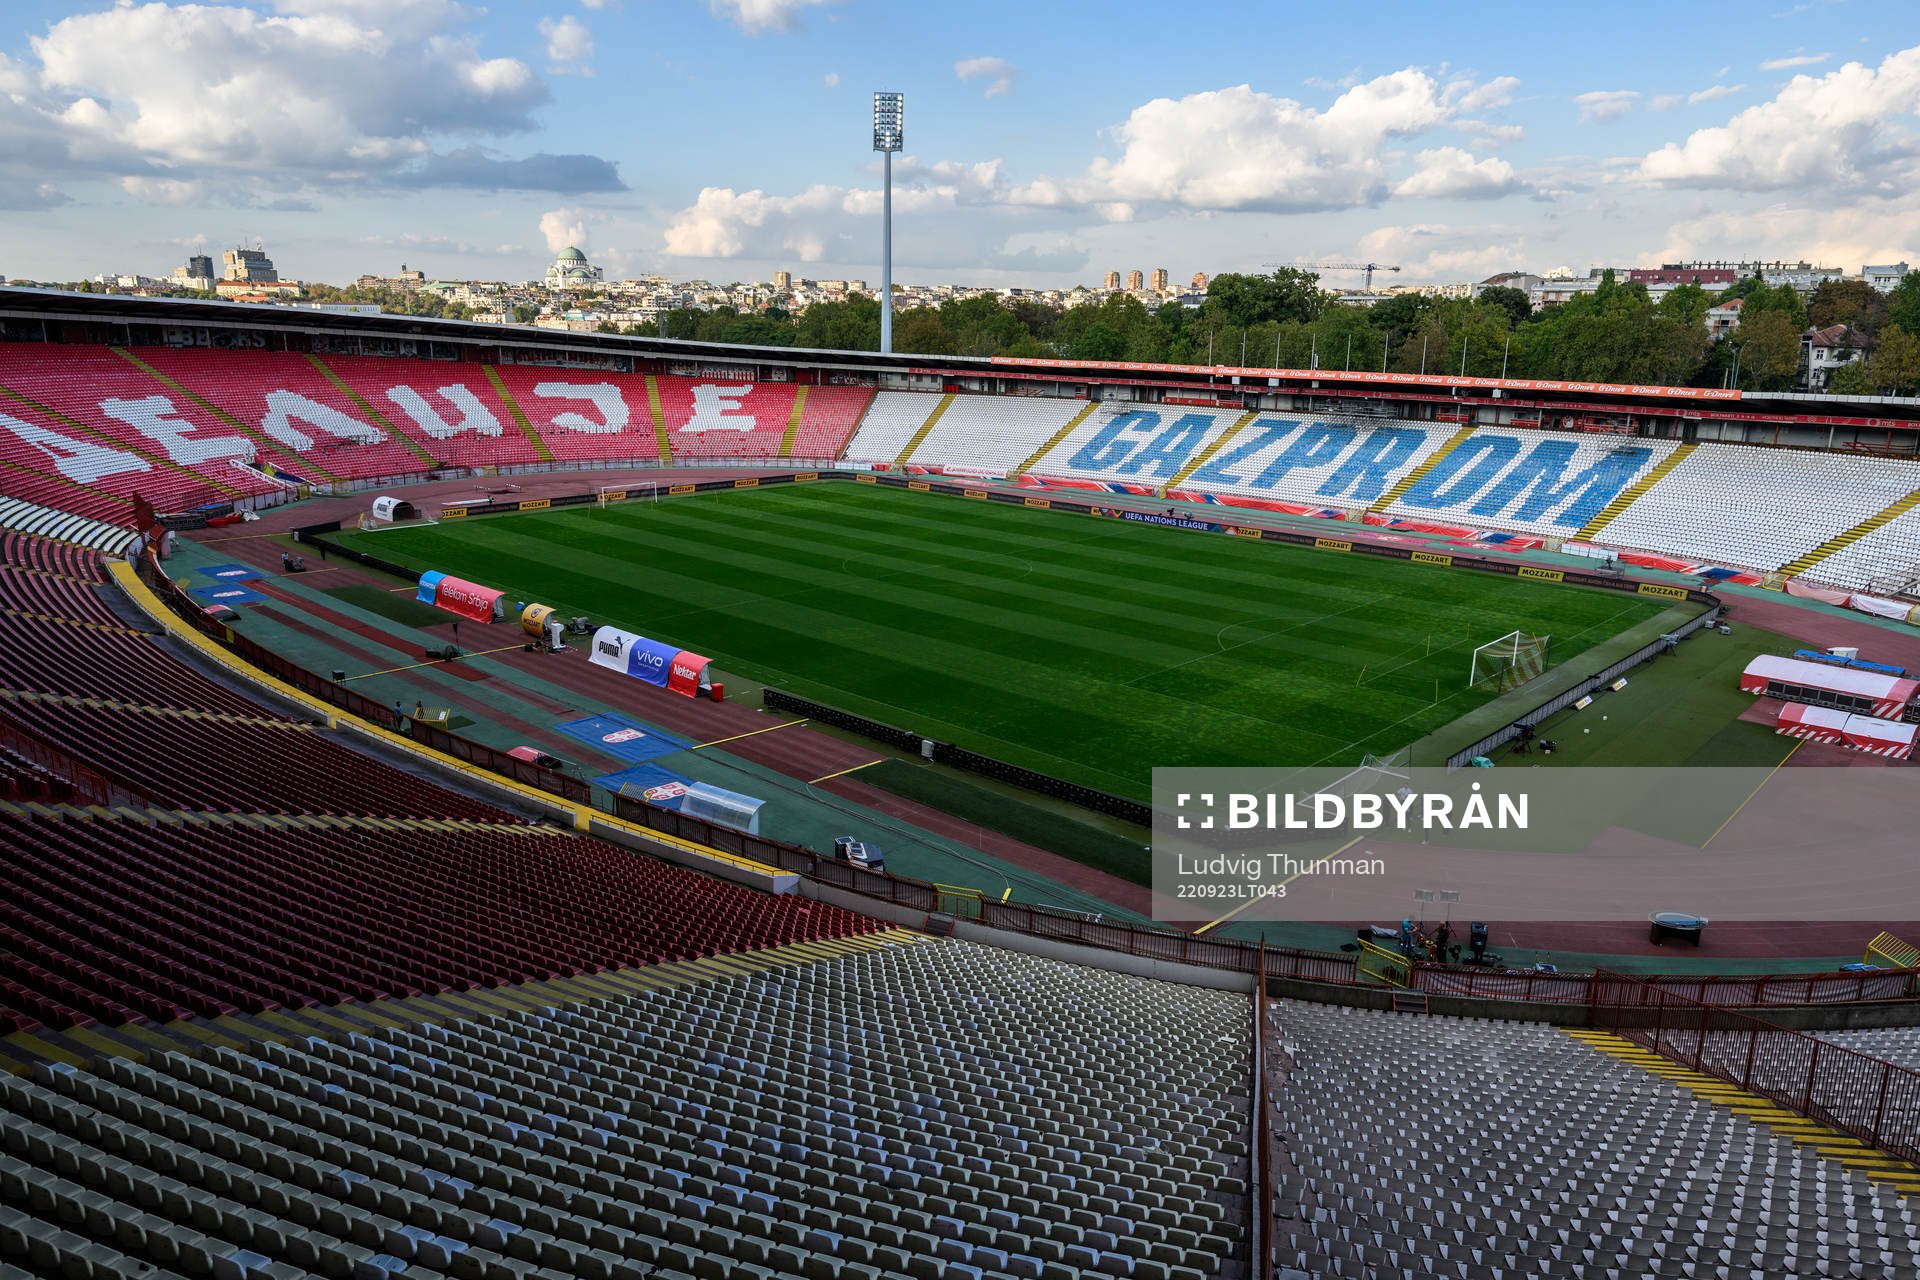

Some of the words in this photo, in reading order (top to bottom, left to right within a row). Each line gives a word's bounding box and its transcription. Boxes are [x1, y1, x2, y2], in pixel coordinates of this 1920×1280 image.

[1067, 408, 1654, 528] GAZPROM
[1125, 512, 1143, 520] UEFA
[1145, 516, 1176, 525] NATIONS
[1179, 519, 1208, 530] LEAGUE
[1318, 540, 1349, 549] MOZZART
[1415, 554, 1449, 563] MOZZART
[1522, 569, 1560, 579] MOZZART
[442, 583, 466, 602] Telekom
[468, 593, 488, 611] Srbija
[1642, 586, 1684, 597] MOZZART
[599, 641, 619, 658] PUMA
[638, 649, 663, 667] vivo
[673, 664, 696, 680] Nektar
